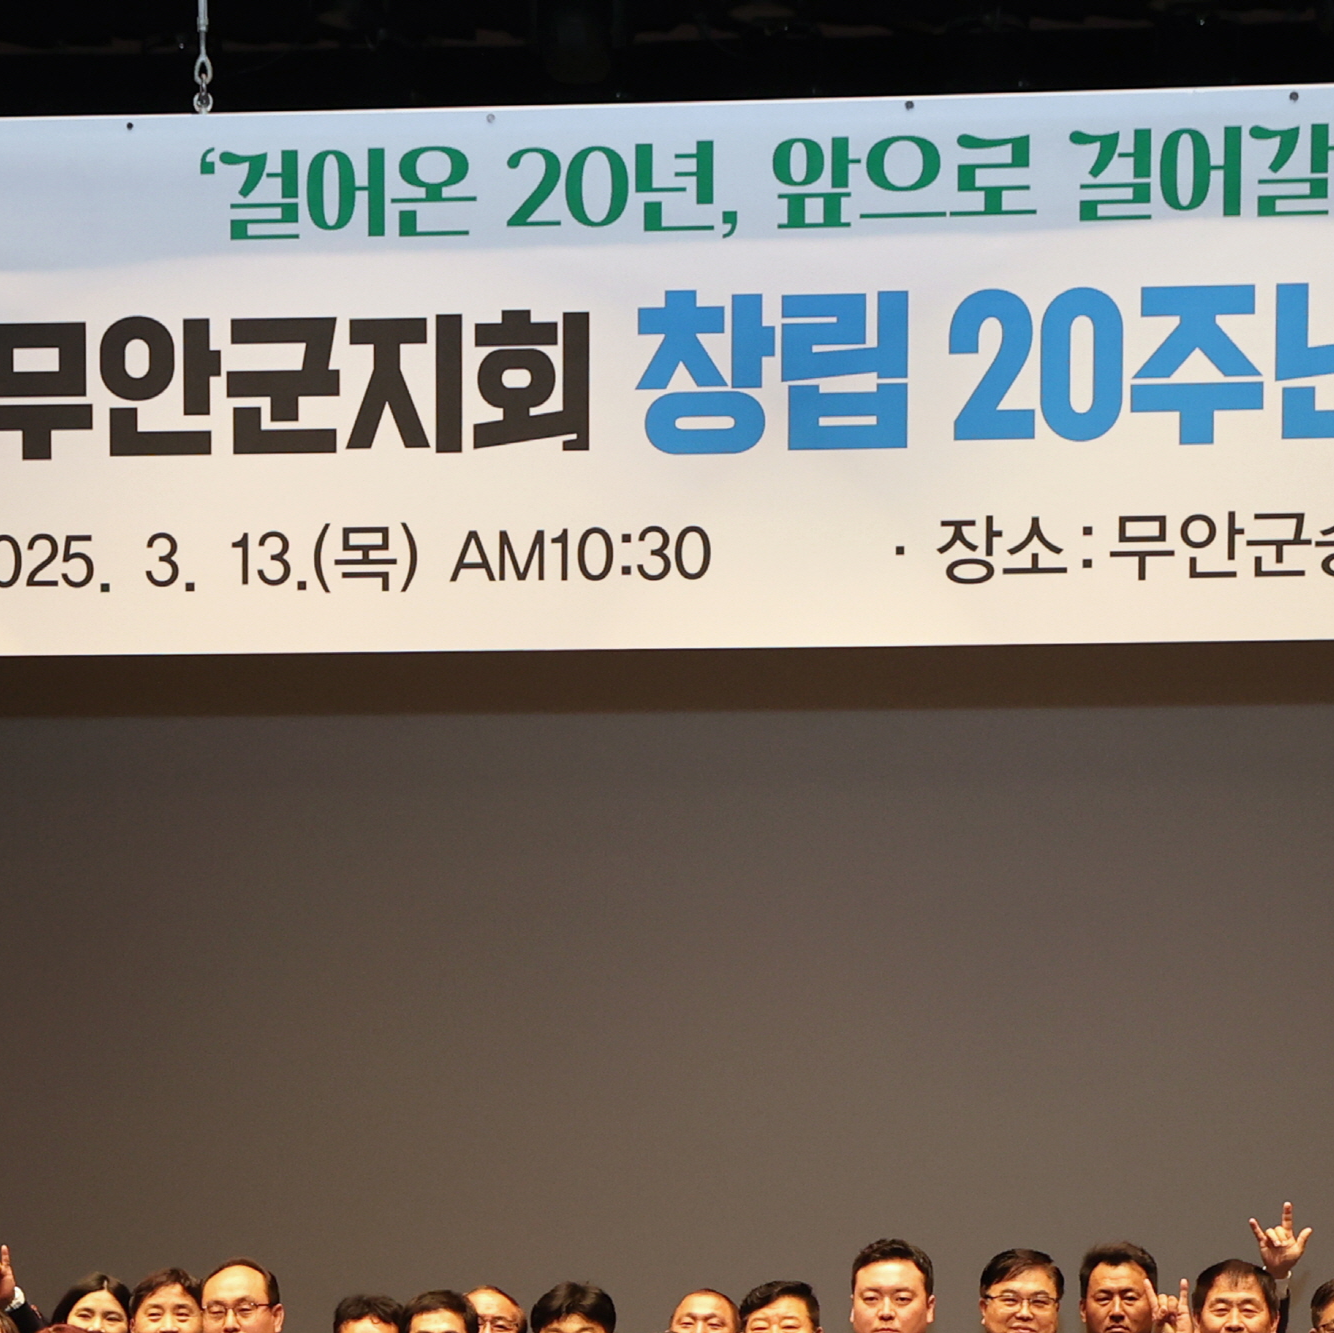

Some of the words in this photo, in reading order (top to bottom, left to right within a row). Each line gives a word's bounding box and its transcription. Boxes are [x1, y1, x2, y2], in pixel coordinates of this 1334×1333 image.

[508, 142, 736, 231] 20년,
[774, 136, 1037, 228] 앞으로
[638, 290, 908, 453] 창립
[146, 533, 194, 591] 3.
[232, 523, 417, 592] 13.(목)
[451, 526, 710, 581] AM10:30
